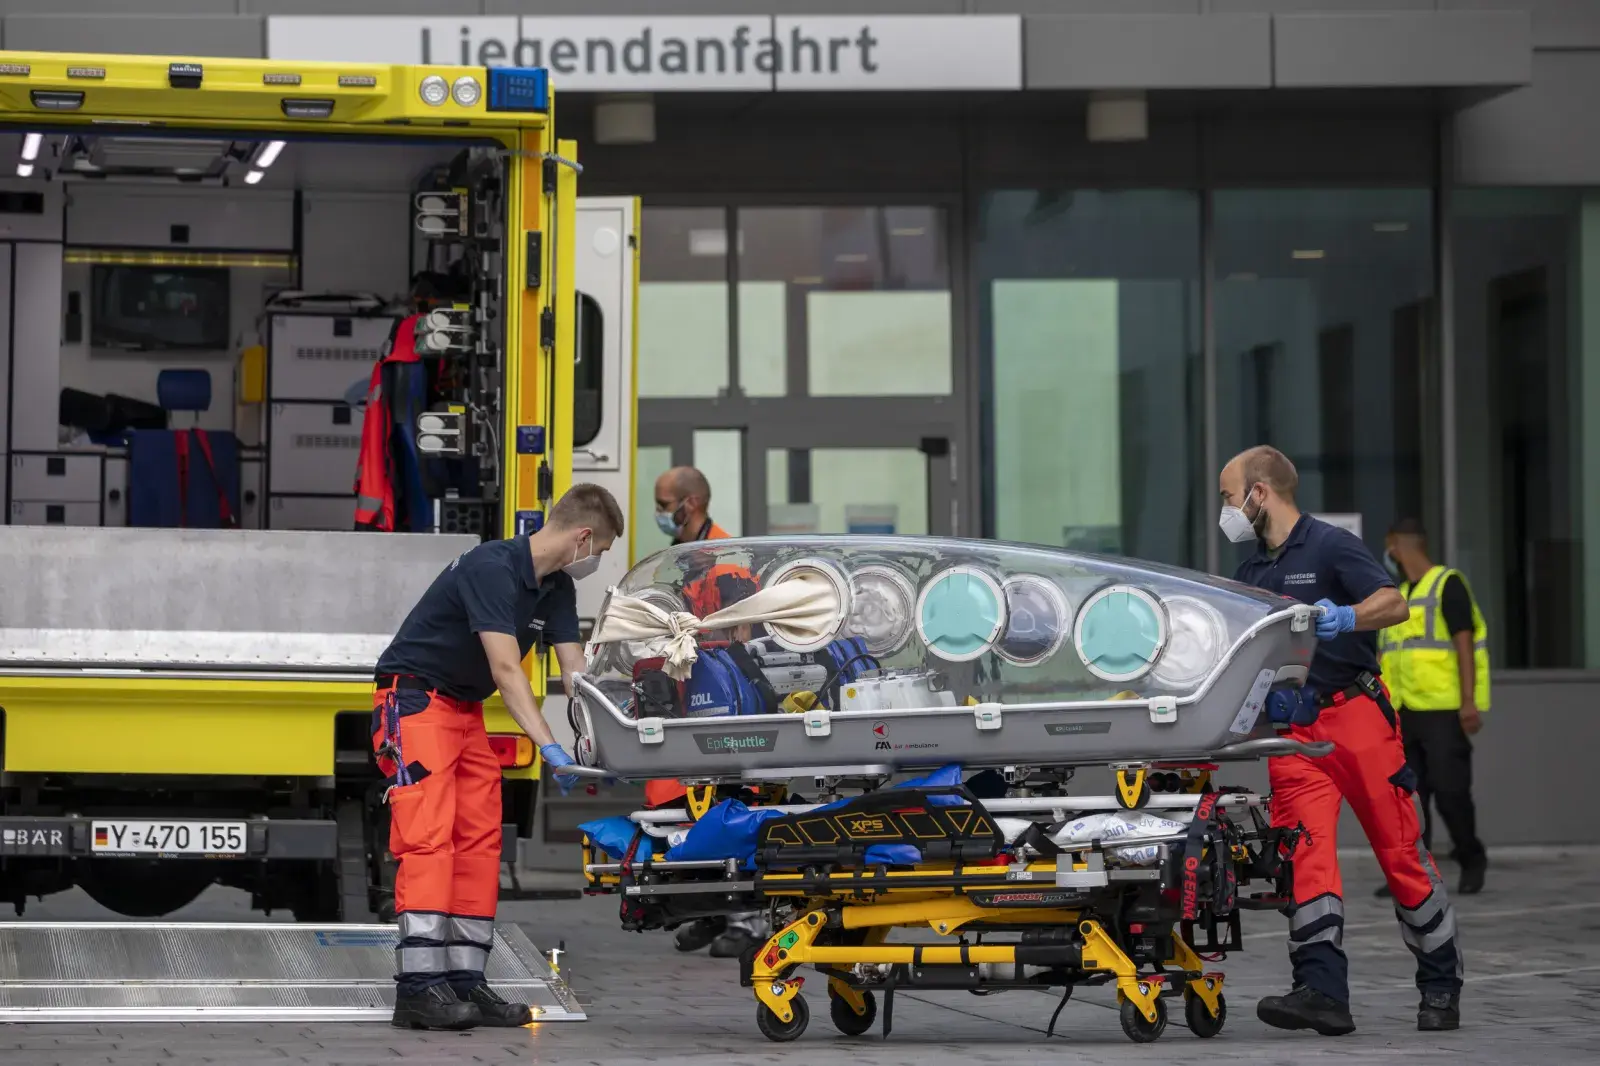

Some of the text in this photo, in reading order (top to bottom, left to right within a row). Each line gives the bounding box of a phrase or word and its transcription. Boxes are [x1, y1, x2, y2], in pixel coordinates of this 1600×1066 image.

[420, 25, 879, 76] Liegendanfahrt
[691, 693, 713, 706] ZOLL
[706, 735, 767, 751] EpiShuttle
[851, 820, 883, 829] XPS
[17, 829, 63, 845] BÄR
[200, 826, 242, 850] 155
